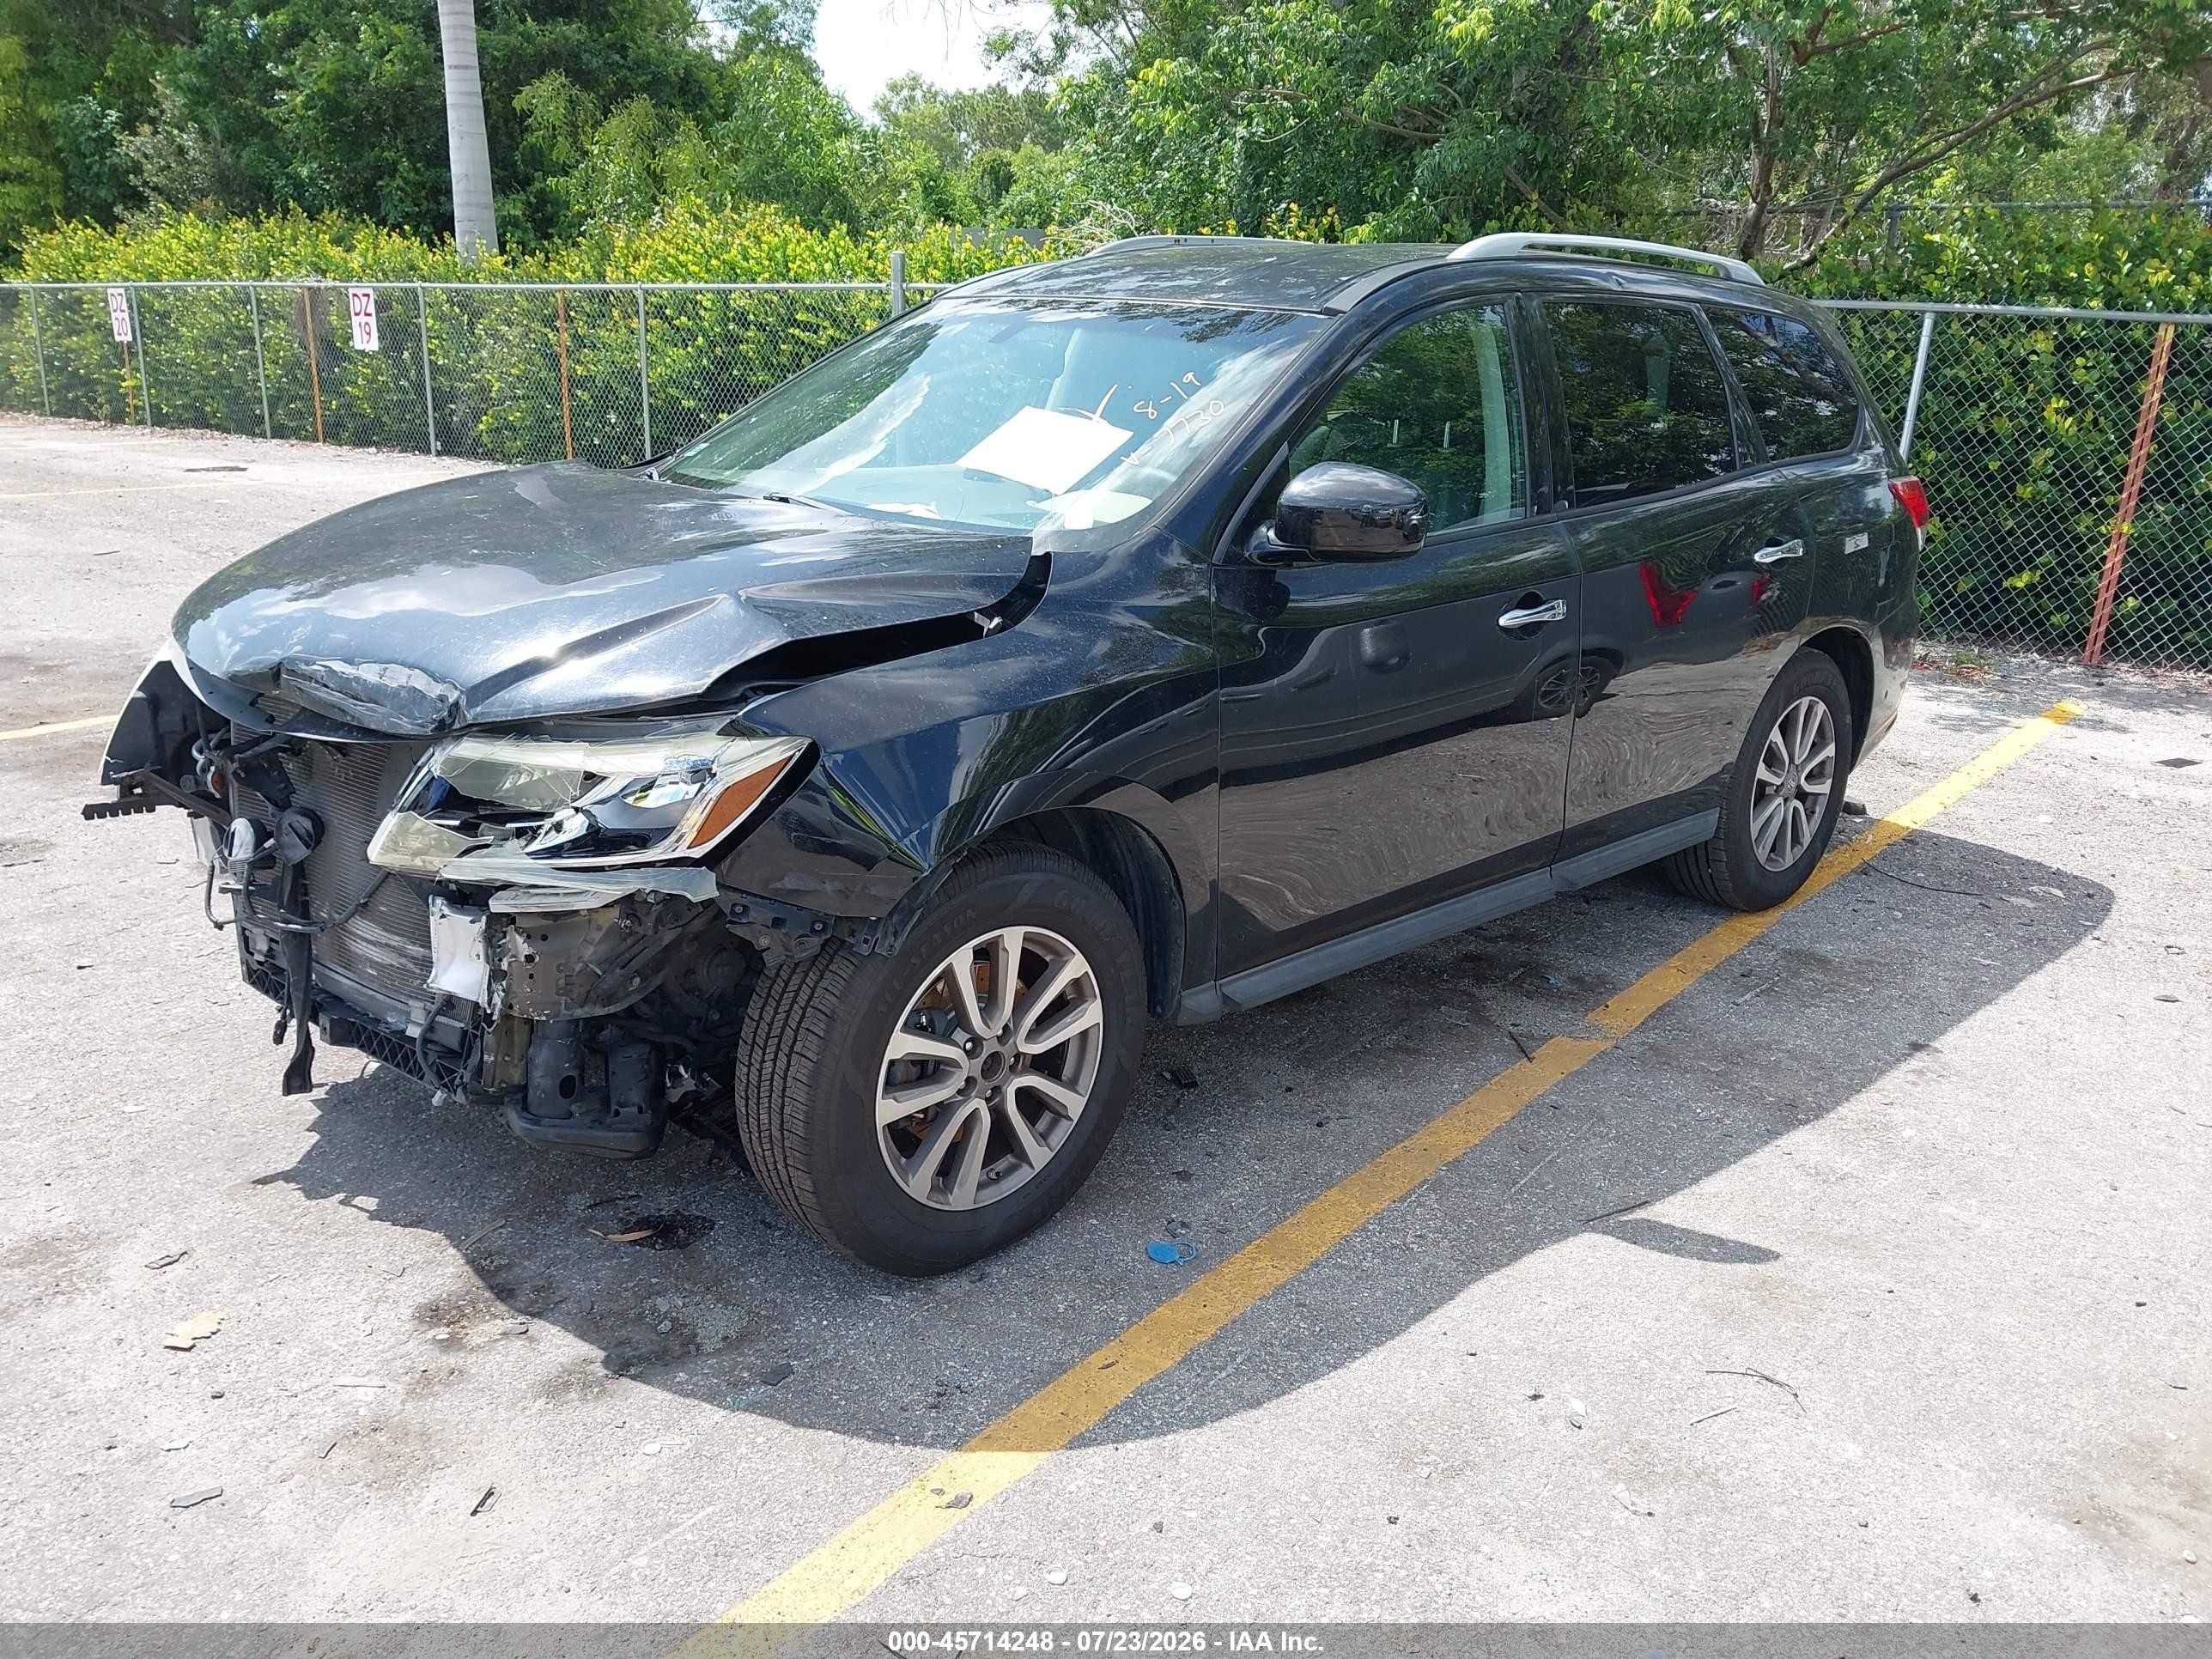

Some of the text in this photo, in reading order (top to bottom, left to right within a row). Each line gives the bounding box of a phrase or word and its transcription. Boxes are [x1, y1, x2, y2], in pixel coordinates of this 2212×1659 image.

[110, 293, 125, 313] DZ
[352, 293, 372, 316] DZ
[114, 317, 128, 336] 20
[358, 321, 372, 343] 19
